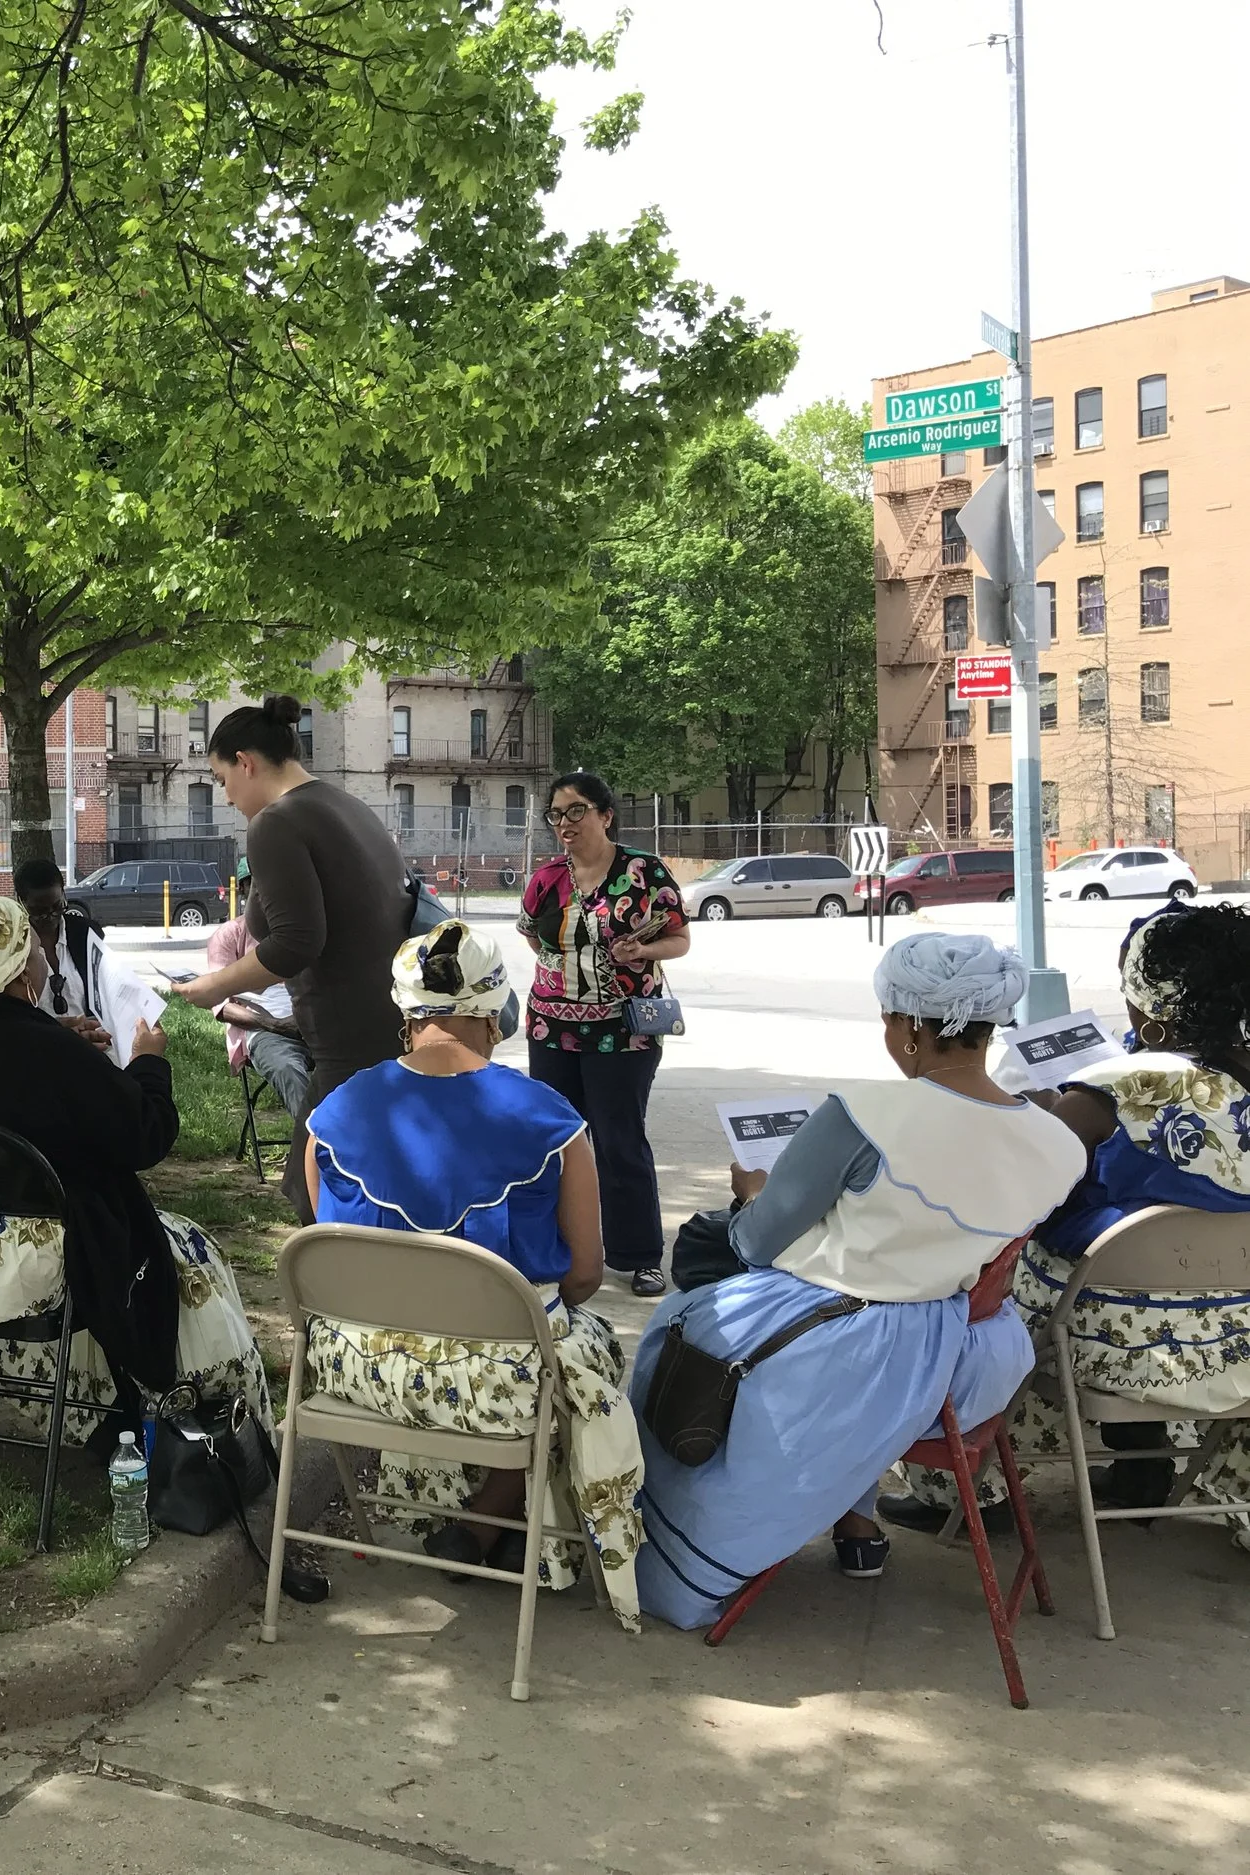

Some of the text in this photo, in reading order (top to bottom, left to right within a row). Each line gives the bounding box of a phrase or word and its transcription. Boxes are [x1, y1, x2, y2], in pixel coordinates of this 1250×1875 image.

[890, 382, 999, 421] Dawson St
[868, 419, 998, 450] Arsenio Rodriguez
[921, 442, 942, 452] Way
[960, 661, 972, 670] NO
[961, 670, 995, 680] Anytime
[1031, 1047, 1055, 1059] RIGHTS
[742, 1127, 766, 1136] RIGHTS
